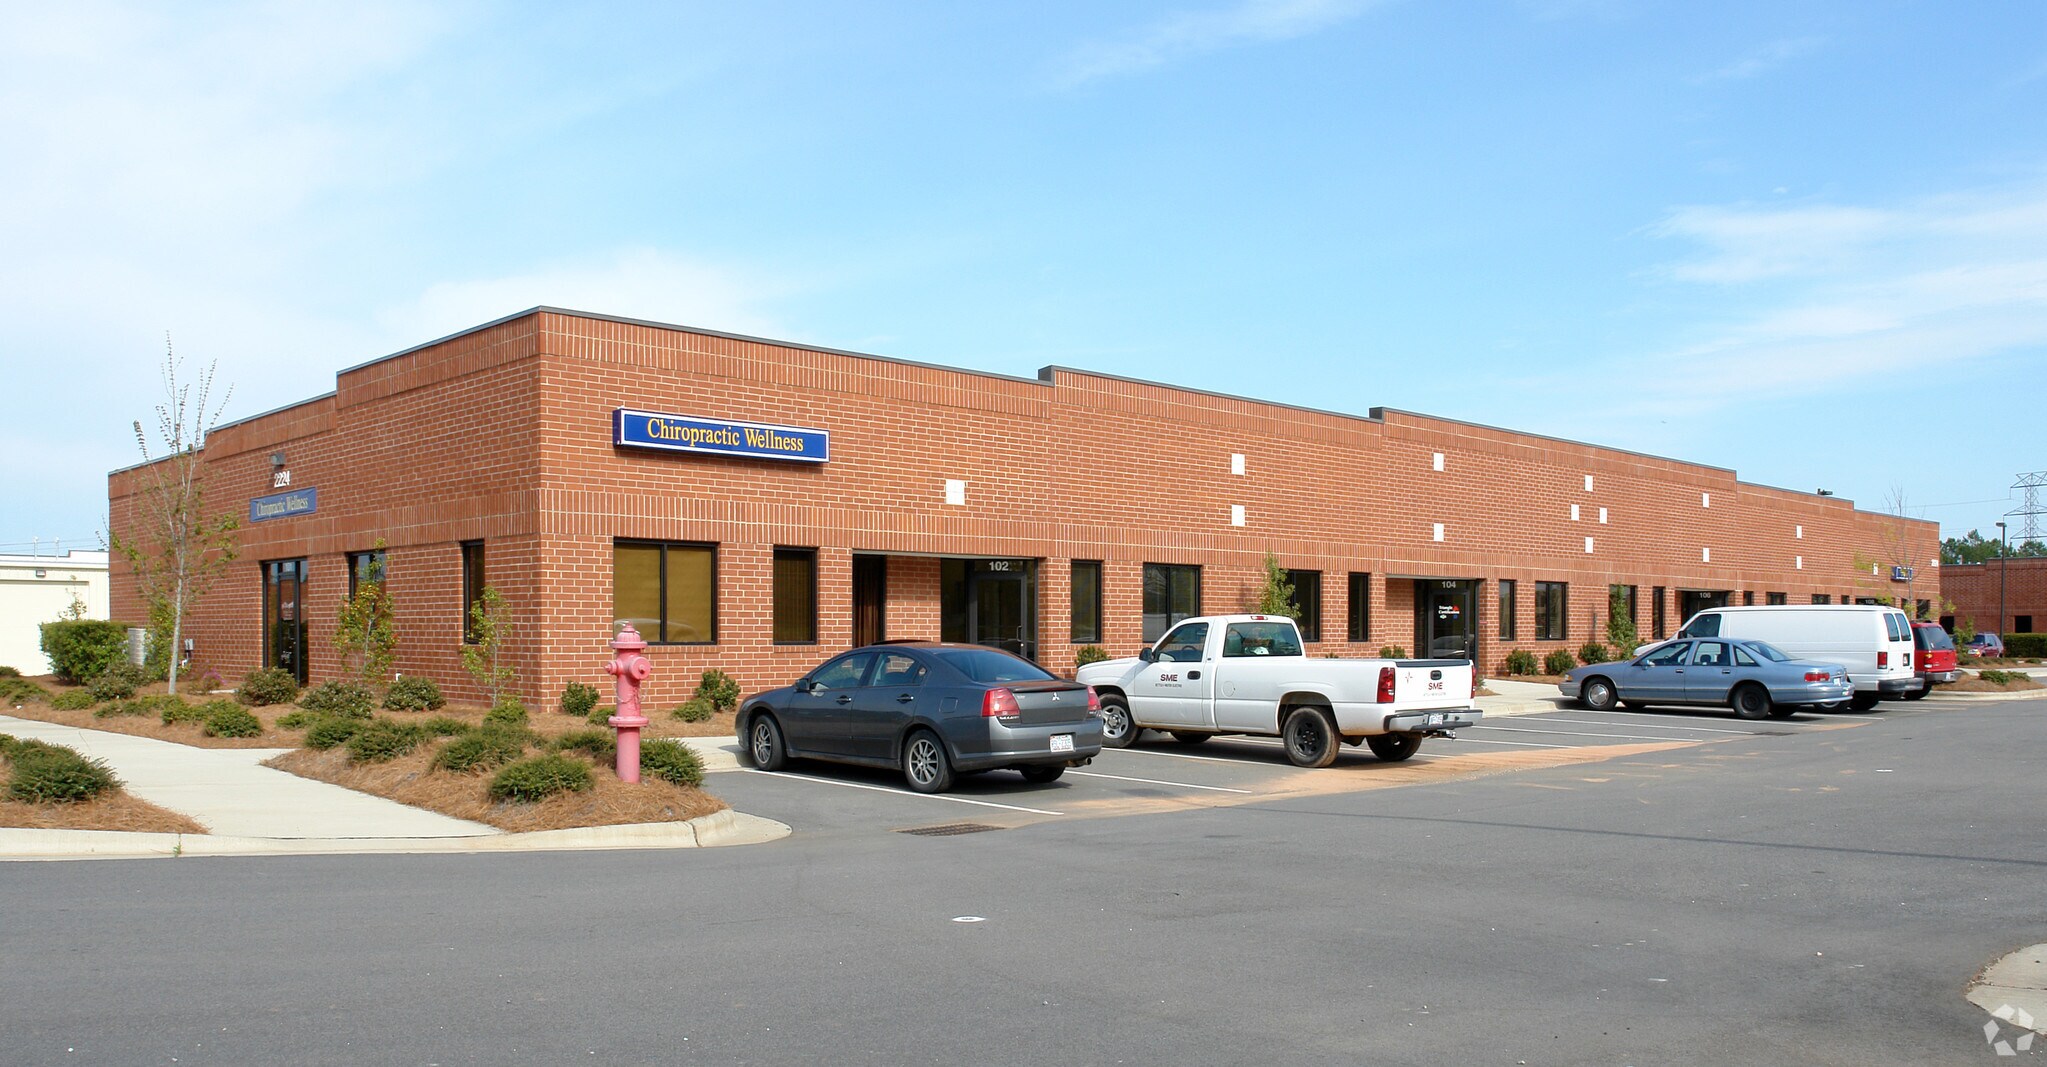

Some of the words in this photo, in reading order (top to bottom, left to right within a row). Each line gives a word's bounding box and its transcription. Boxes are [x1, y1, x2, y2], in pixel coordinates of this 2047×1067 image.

[647, 417, 740, 447] Chiropractic
[744, 427, 804, 452] Wellness
[274, 470, 290, 488] 2224
[988, 561, 1009, 571] 102
[1160, 674, 1178, 682] SME
[1428, 682, 1443, 690] SME
